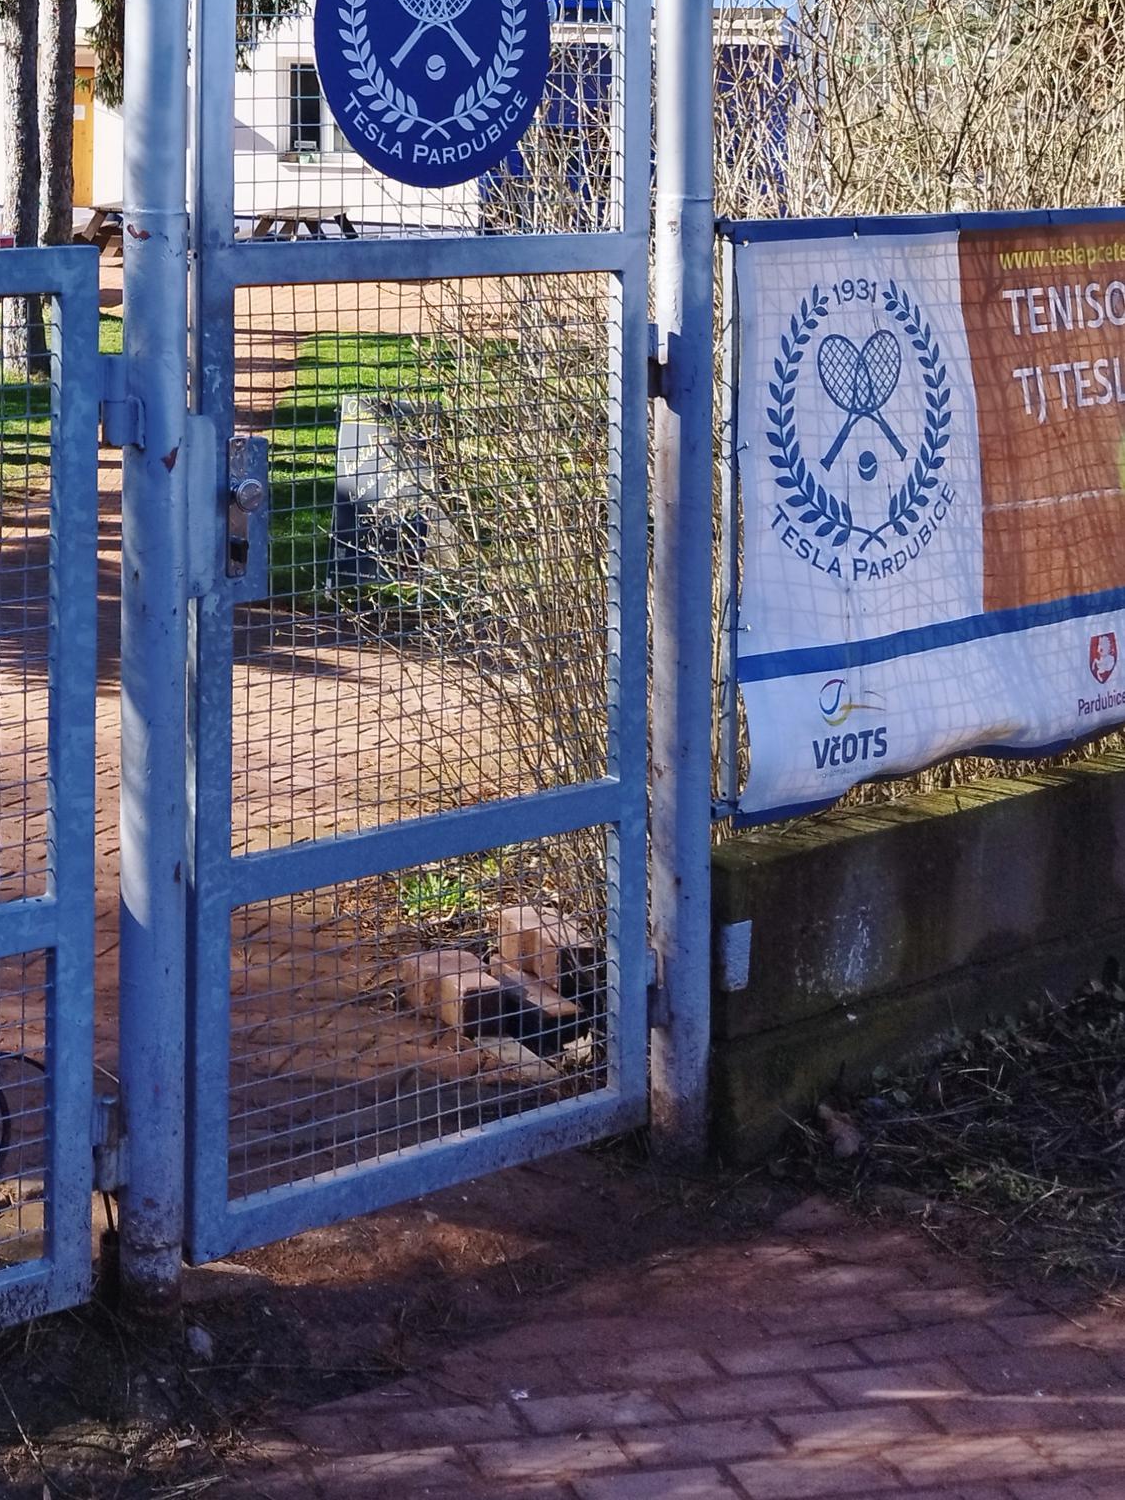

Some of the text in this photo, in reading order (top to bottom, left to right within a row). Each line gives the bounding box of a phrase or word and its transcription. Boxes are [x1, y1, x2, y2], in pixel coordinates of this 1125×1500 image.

[343, 90, 528, 165] TESLA PARDUBICE
[832, 278, 878, 305] 1931
[1002, 280, 1125, 336] TENISO
[1013, 357, 1125, 424] TJ TESL
[770, 482, 957, 582] TESLA PARDUBICE
